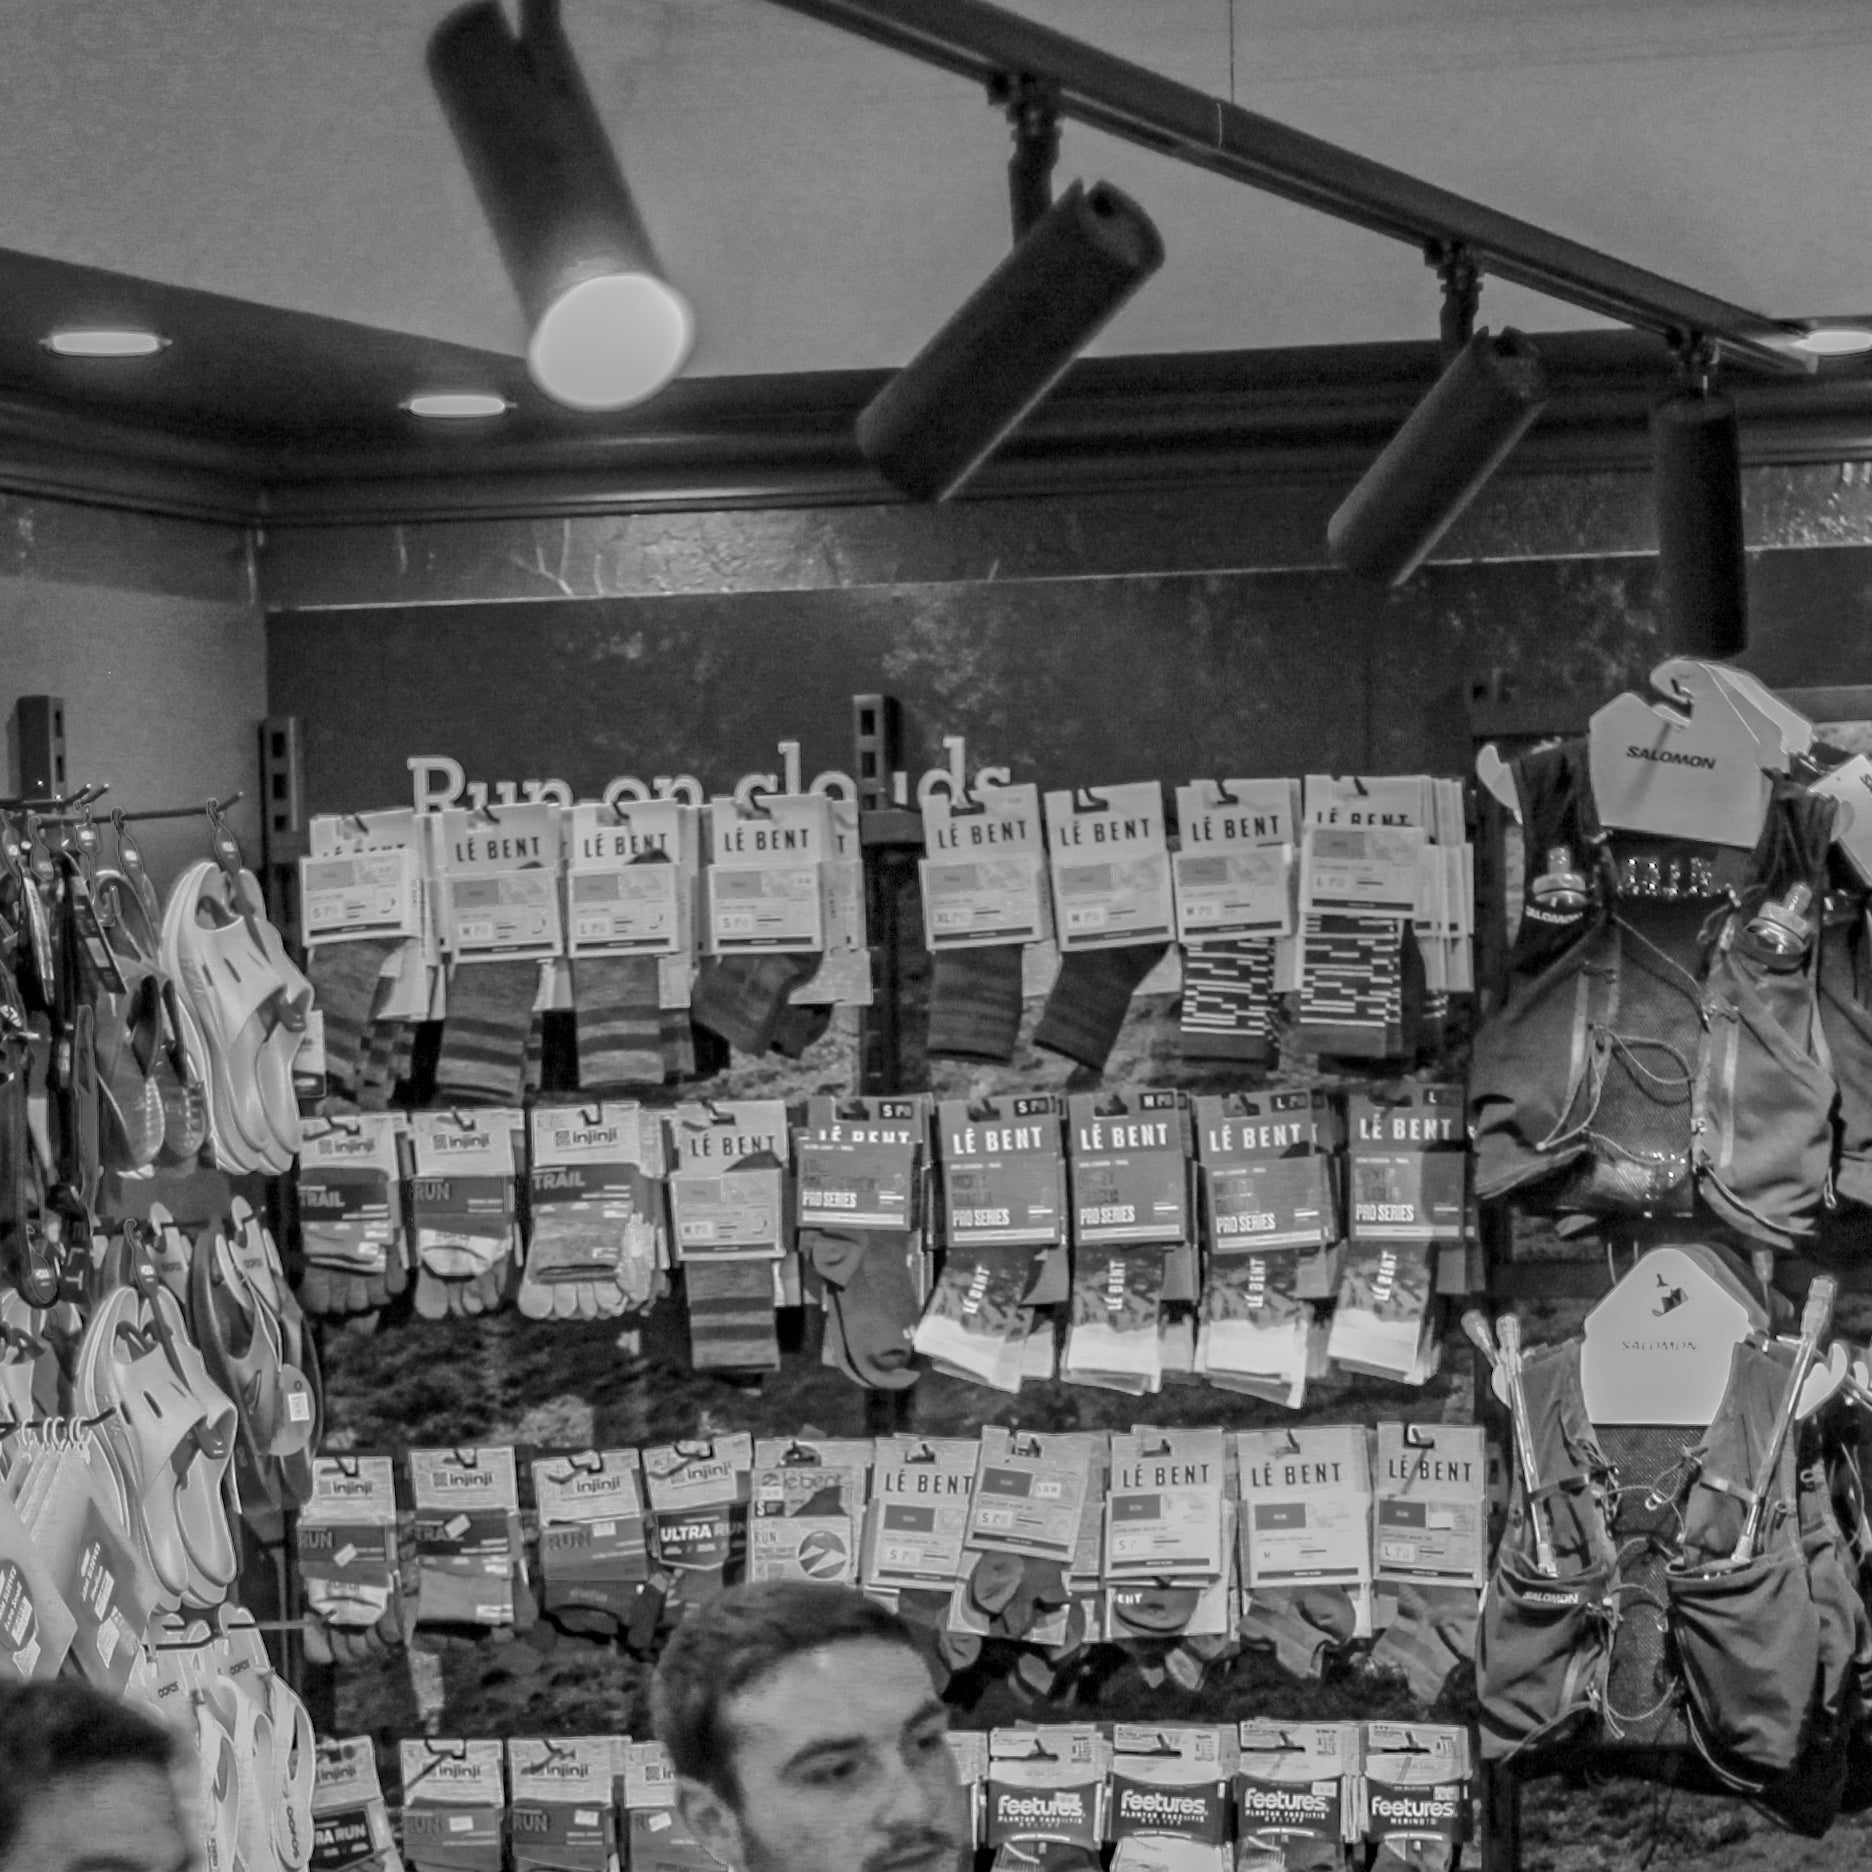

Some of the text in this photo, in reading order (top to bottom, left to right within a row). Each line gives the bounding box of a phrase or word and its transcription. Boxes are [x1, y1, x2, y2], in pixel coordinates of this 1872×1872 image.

[1626, 744, 1717, 771] SALOMON
[969, 819, 1027, 846] BENT
[1092, 818, 1152, 844] BENT
[1222, 814, 1281, 839] BENT
[486, 836, 540, 860] BENT
[614, 830, 669, 857] BENT
[750, 827, 810, 852] BENT
[1079, 1120, 1169, 1151] LÉ BENT
[1208, 1120, 1302, 1153] LÉ BENT
[1359, 1109, 1451, 1142] LÉ BENT
[445, 1130, 492, 1154] injinji
[570, 1127, 619, 1149] injinji
[722, 1134, 777, 1158] BENT
[952, 1120, 1042, 1156] LÉ BENT
[412, 1180, 451, 1201] RUN
[532, 1171, 586, 1191] TRAIL
[952, 1208, 1010, 1228] PRO SERIES
[1080, 1205, 1136, 1226] PRO SERIES
[1215, 1213, 1276, 1234] PRO SERIES
[1355, 1203, 1415, 1224] PRO SERIES
[1620, 1338, 1702, 1353] SALOMON
[448, 1471, 494, 1491] injinji
[1122, 1461, 1211, 1490] LÉ BENT
[1251, 1460, 1342, 1488] LÉ BENT
[1419, 1460, 1473, 1483] BENT
[332, 1479, 374, 1498] injinji
[575, 1475, 624, 1497] injinji
[916, 1474, 973, 1496] BENT
[659, 1526, 711, 1542] ULTRA
[436, 1760, 482, 1781] injinji
[998, 1794, 1084, 1817] feetures
[1120, 1789, 1208, 1814] feetures
[1245, 1787, 1331, 1812] feetures
[1371, 1795, 1456, 1818] feetures
[335, 1823, 368, 1844] RUN
[512, 1812, 549, 1834] RUN
